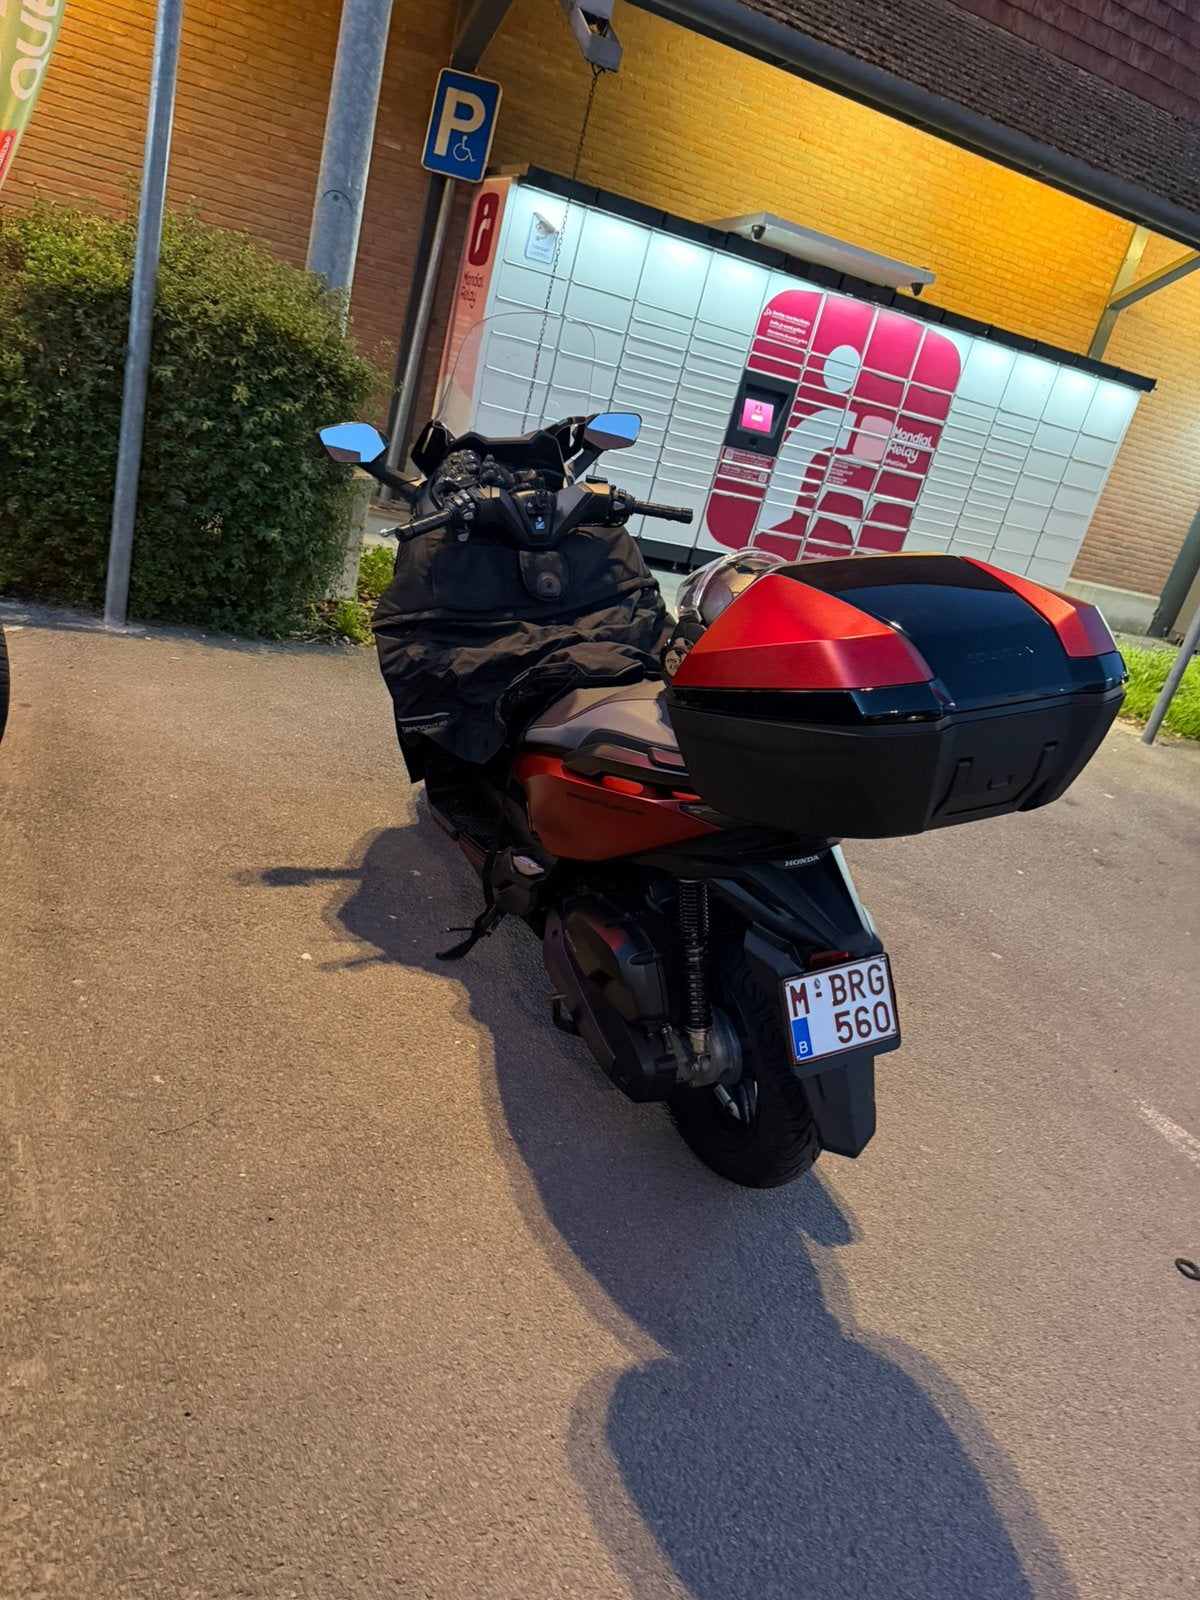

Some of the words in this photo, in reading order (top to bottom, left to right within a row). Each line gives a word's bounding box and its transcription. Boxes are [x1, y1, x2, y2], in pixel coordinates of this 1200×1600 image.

[433, 86, 486, 157] P
[893, 426, 933, 448] Mondial
[890, 442, 919, 464] Relay
[784, 854, 820, 867] HONDA
[833, 1000, 891, 1044] 560
[798, 1040, 809, 1055] B
